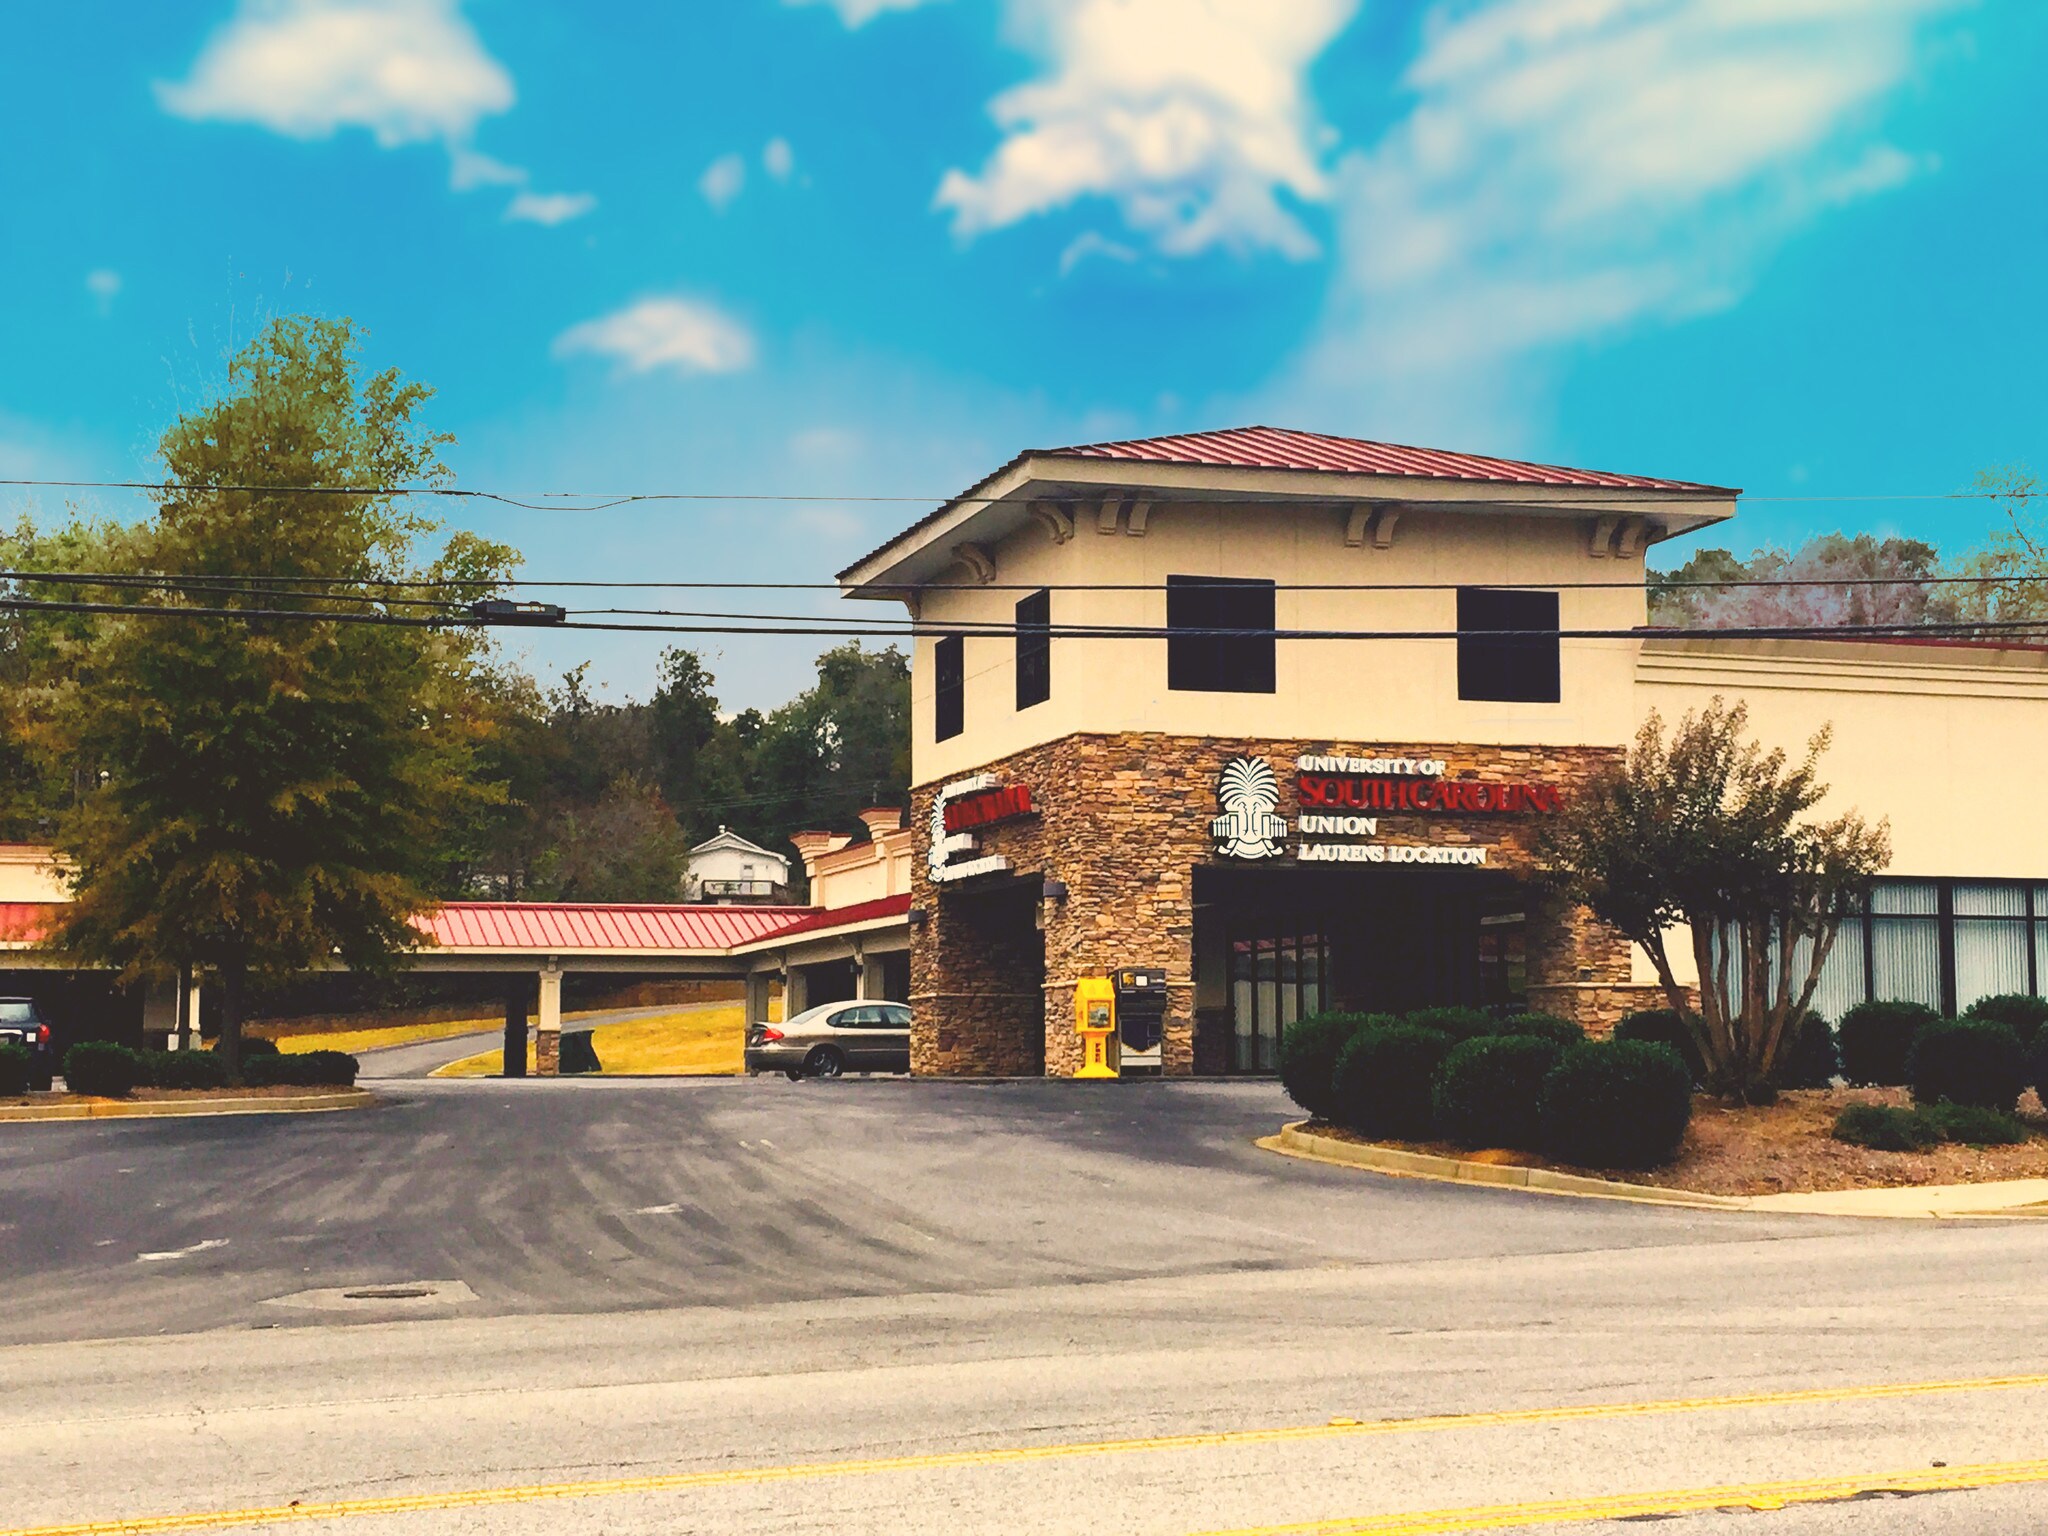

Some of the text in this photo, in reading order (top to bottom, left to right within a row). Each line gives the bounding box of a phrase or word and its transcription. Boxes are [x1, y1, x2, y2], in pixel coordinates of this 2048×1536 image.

[1299, 754, 1446, 776] UNIVERSITY OF
[1298, 776, 1408, 810] SOUTH
[1299, 815, 1377, 836] UNION
[1297, 843, 1487, 865] LAURENS LOCATION
